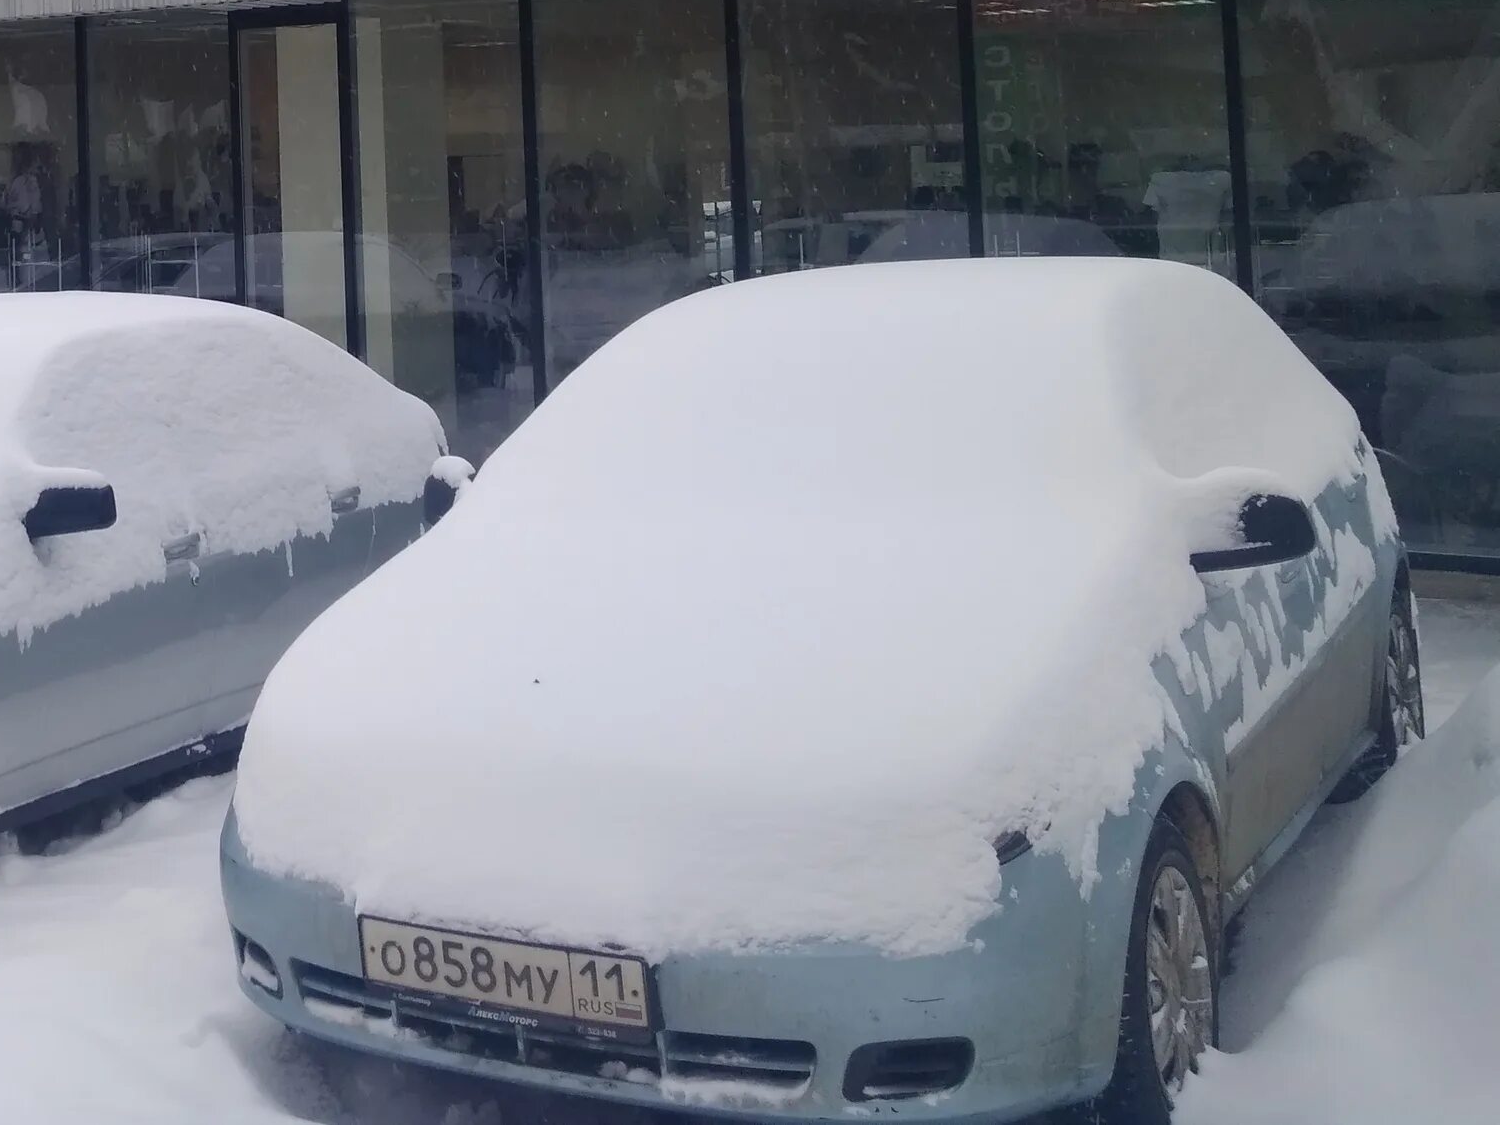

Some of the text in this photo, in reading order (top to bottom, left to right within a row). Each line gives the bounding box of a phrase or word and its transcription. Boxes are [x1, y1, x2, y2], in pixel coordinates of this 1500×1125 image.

[380, 936, 626, 1004] О858МУ 11
[577, 997, 614, 1016] RUS
